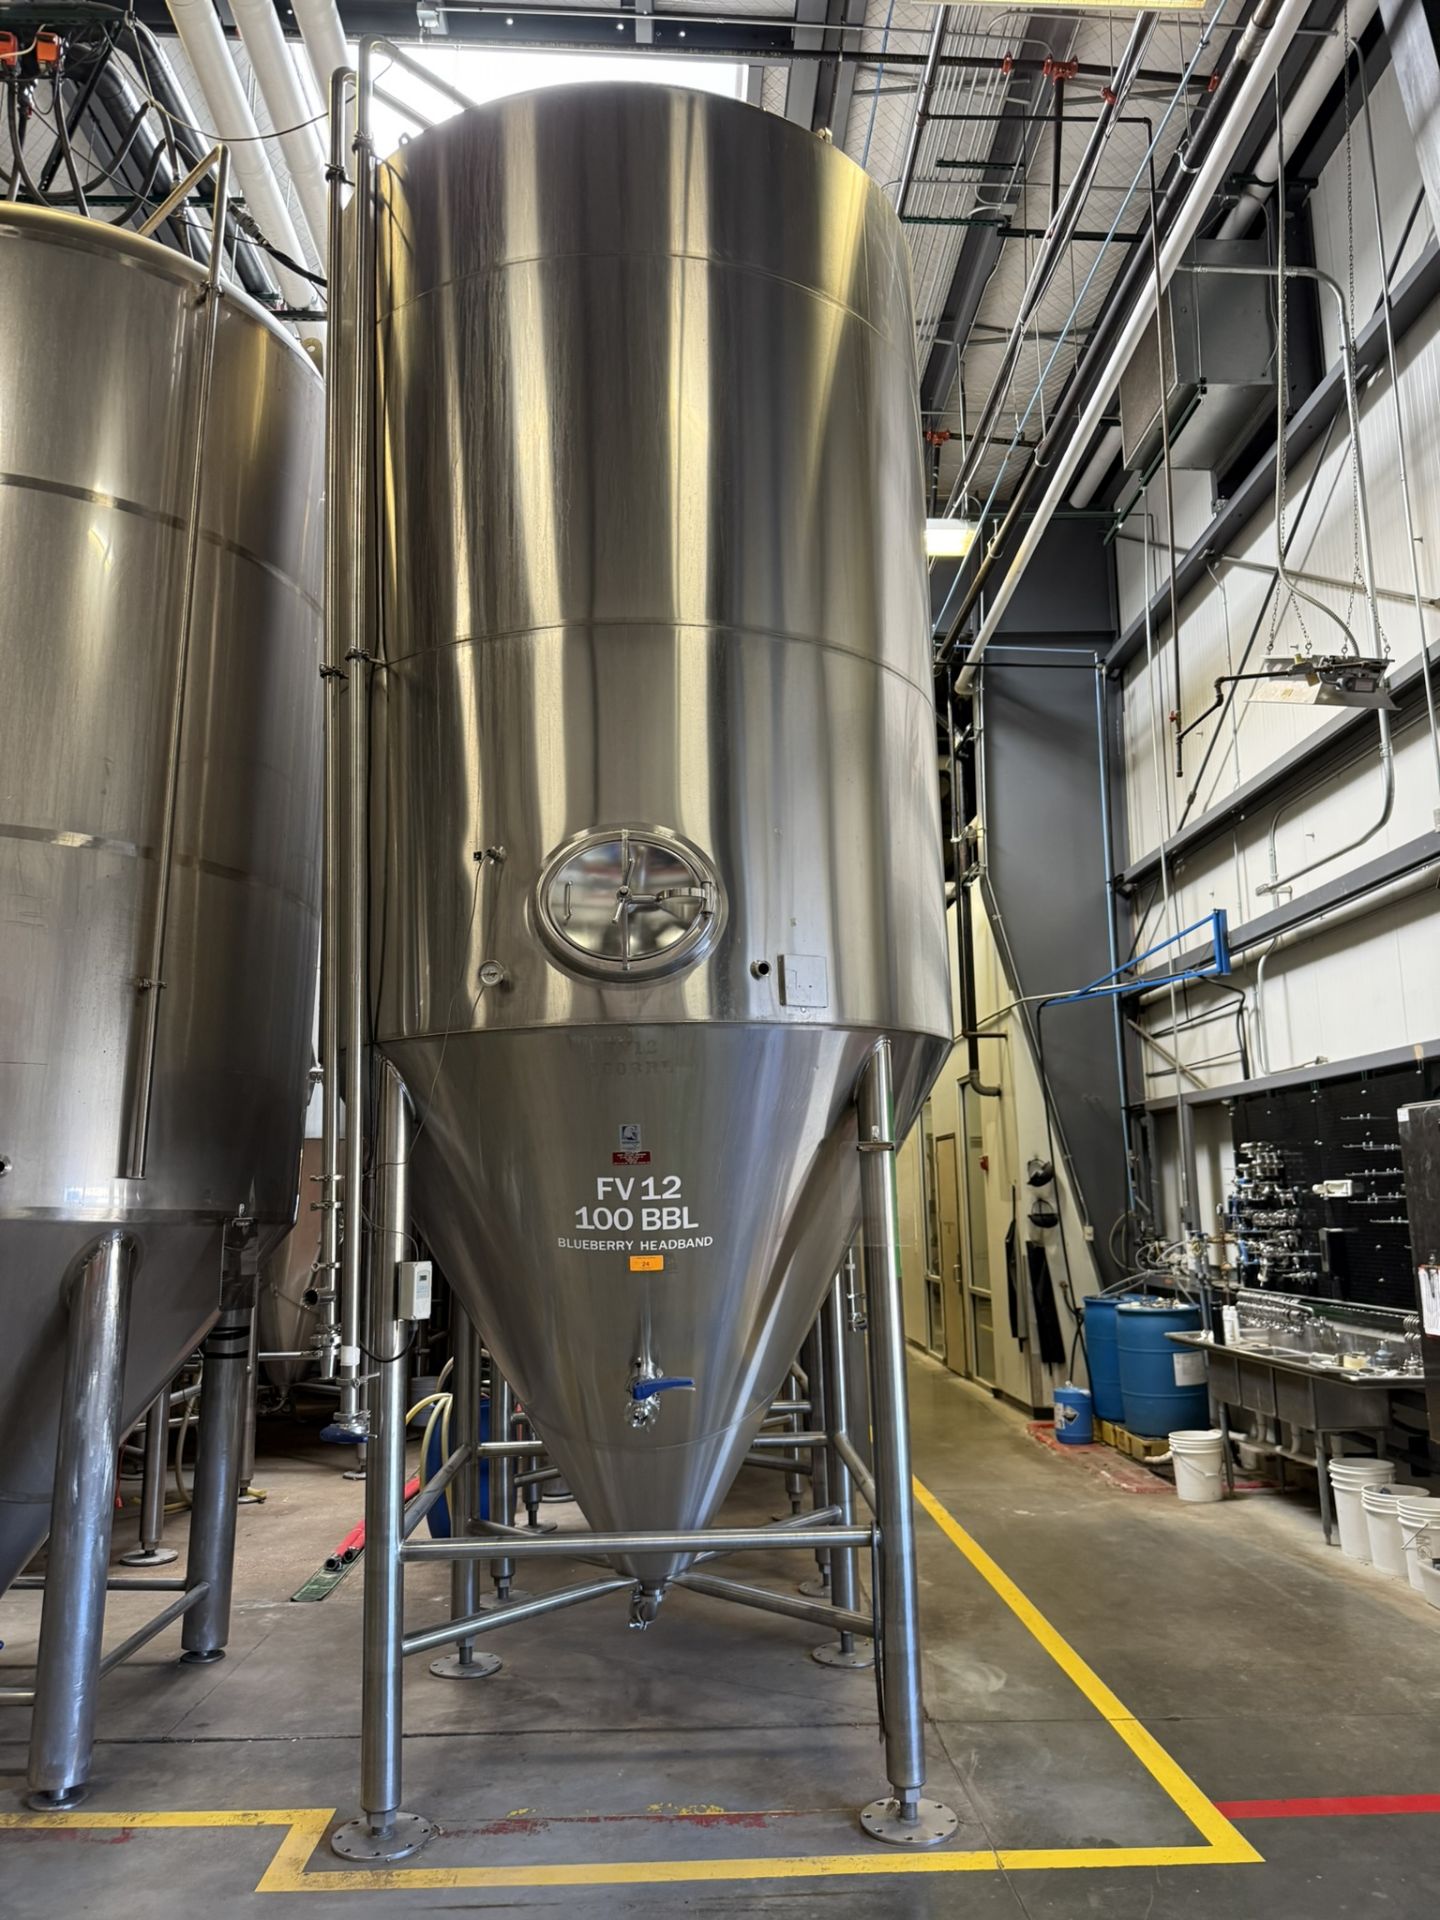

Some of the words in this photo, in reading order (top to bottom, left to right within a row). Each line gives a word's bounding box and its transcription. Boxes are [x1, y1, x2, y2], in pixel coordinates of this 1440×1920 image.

[597, 1177, 635, 1201] FV
[641, 1175, 682, 1200] 12
[575, 1206, 634, 1231] 100
[641, 1206, 699, 1231] BBL
[558, 1237, 634, 1250] BLUEBERRY
[640, 1236, 713, 1250] HEADBAND
